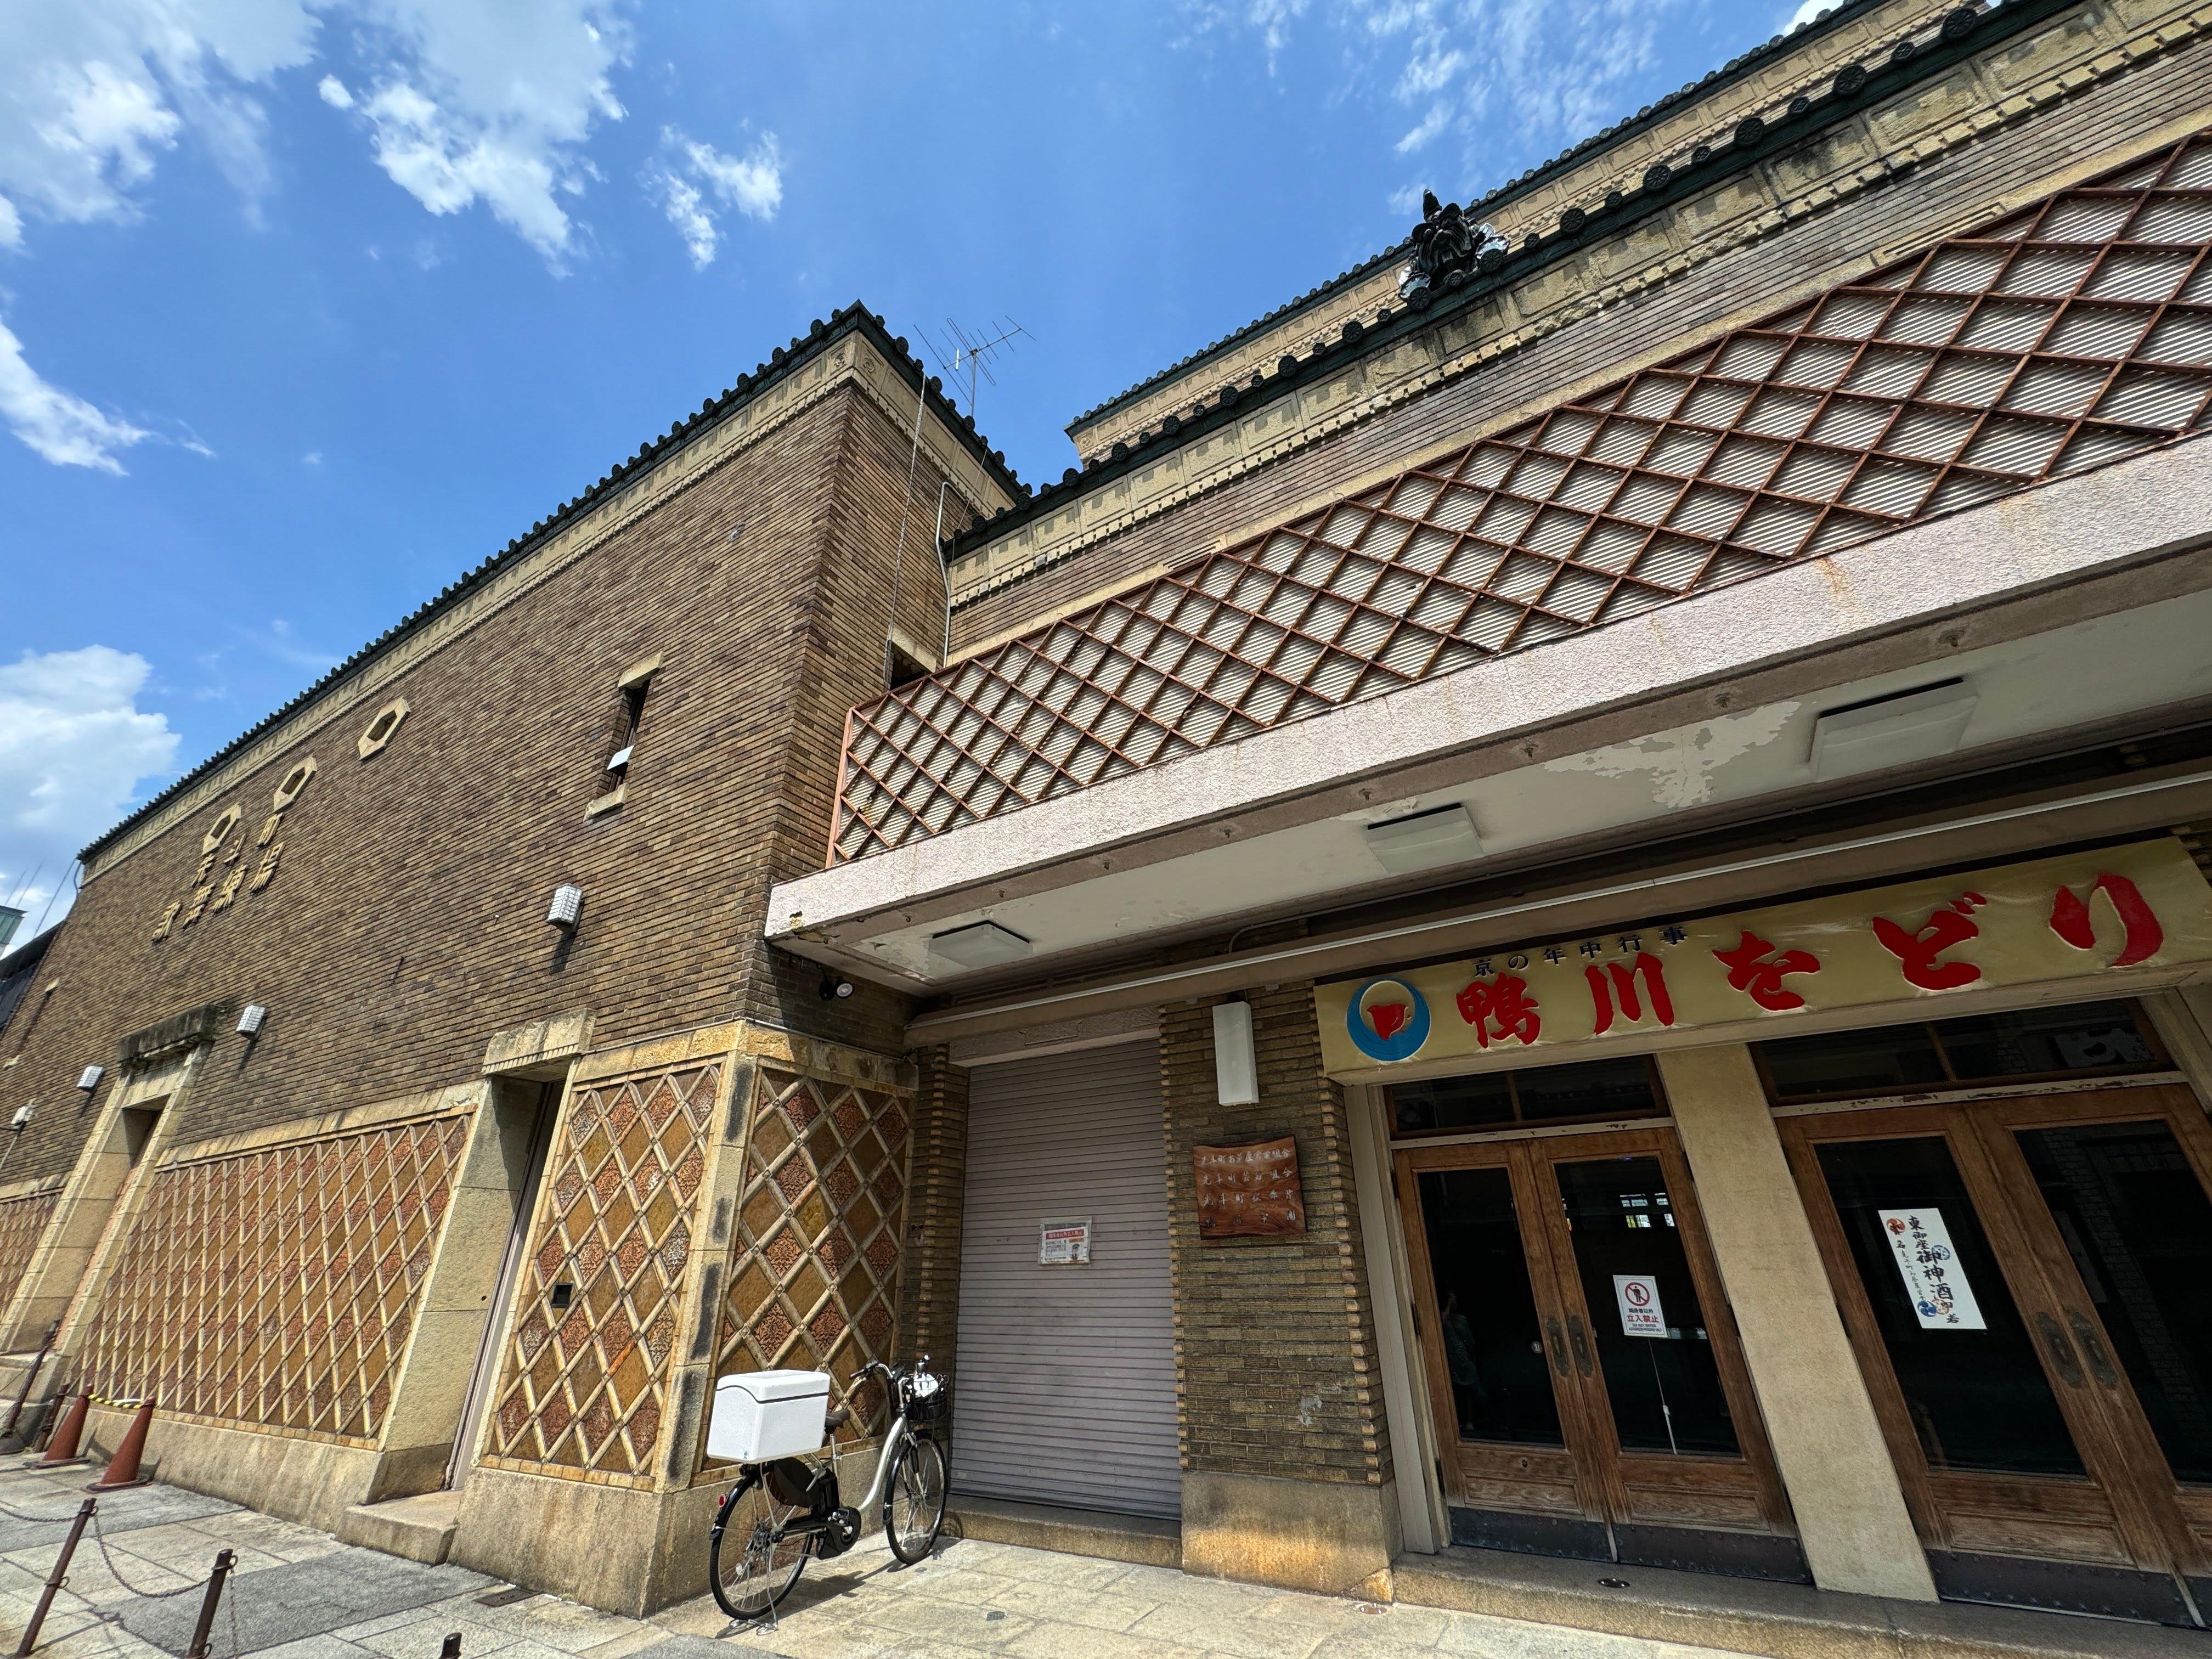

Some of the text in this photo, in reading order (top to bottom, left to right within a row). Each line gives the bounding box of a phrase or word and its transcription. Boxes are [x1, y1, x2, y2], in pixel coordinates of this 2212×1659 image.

[1456, 871, 2164, 1048] 鴨川をどり
[1473, 926, 1688, 977] 京の年中行事
[1627, 1314, 1660, 1323] 立入禁止
